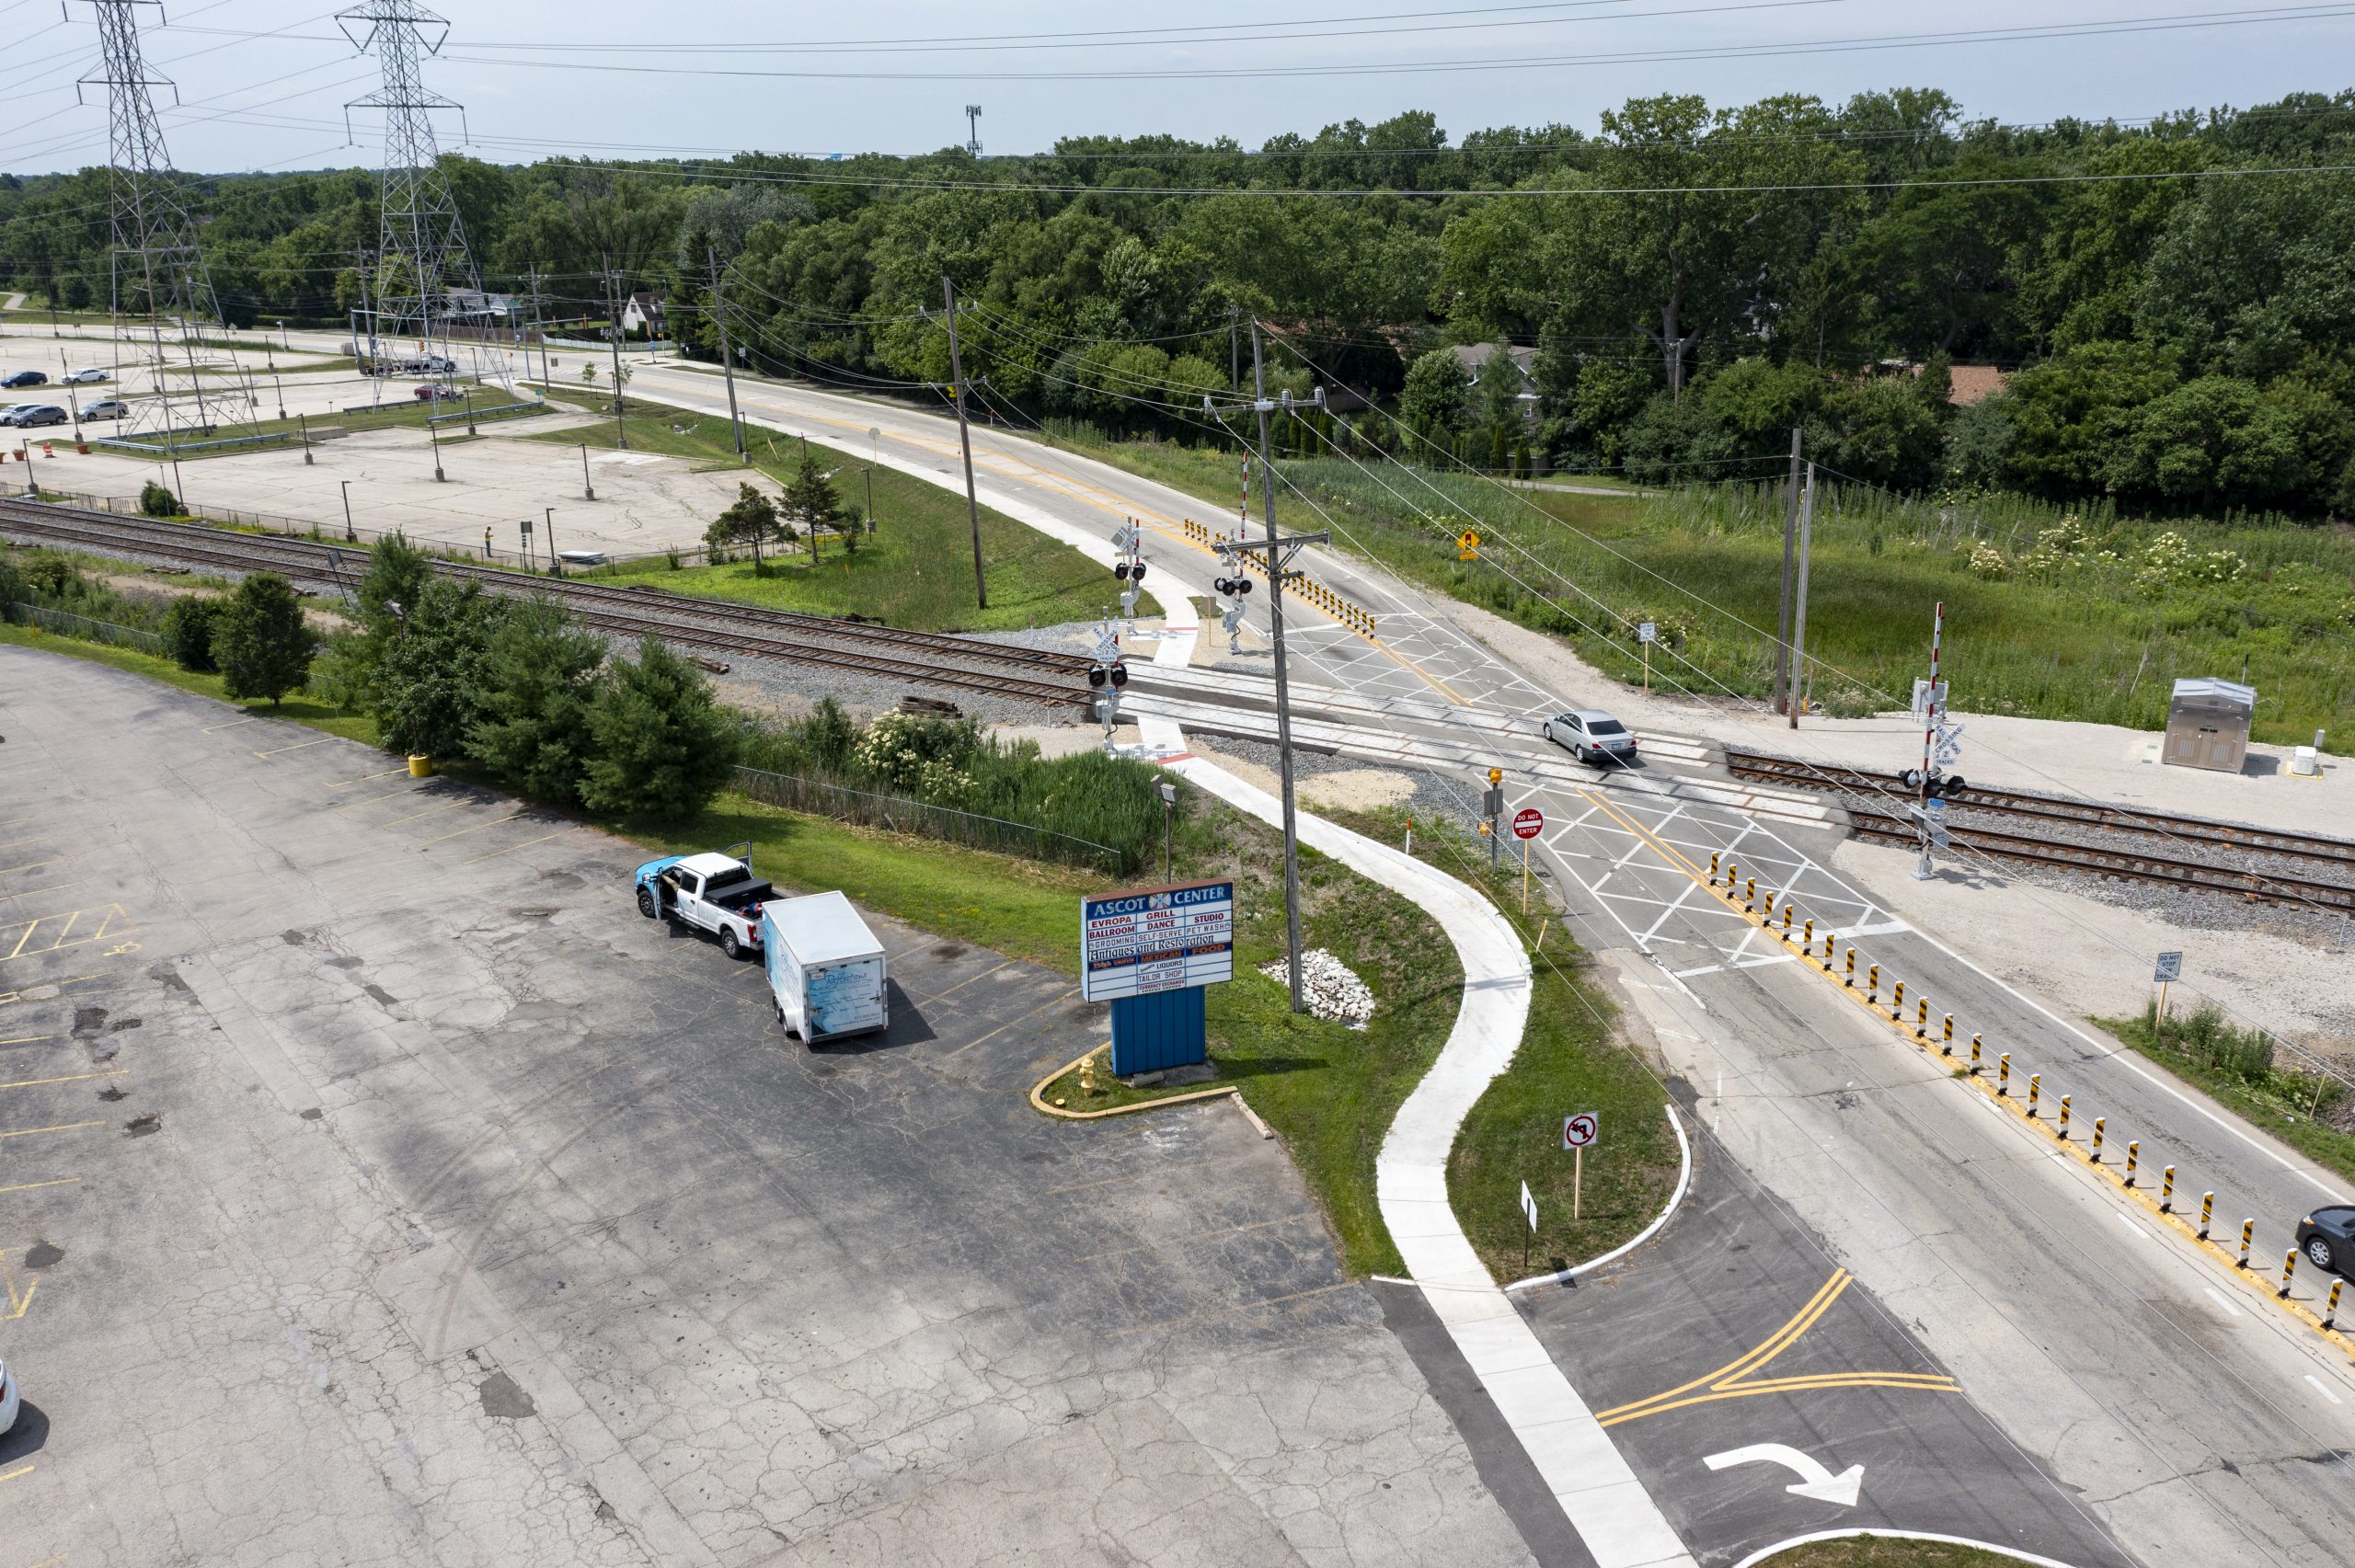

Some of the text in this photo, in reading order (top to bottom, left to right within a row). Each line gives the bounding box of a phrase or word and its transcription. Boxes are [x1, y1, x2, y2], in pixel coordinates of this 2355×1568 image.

[1094, 628, 1103, 638] RAIL
[1097, 630, 1117, 651] CROSSING
[1936, 725, 1961, 754] RAIL ROAD
[1936, 727, 1962, 753] CROSSING
[1094, 887, 1224, 916] ASCOT CENTER
[1089, 912, 1223, 939] BALLROOM DANCE STUDIO
[1091, 910, 1175, 928] EVROPA GRILL
[1095, 936, 1134, 948] GROOMING
[1138, 929, 1182, 942] SELF-SERVE
[1203, 923, 1224, 933] WASH
[1090, 934, 1214, 961] Antiques and Restoration
[1141, 951, 1181, 963] MEXICAN
[1191, 944, 1225, 956] FOOD
[1156, 960, 1183, 969] LIQUORS
[826, 971, 867, 986] Reflections
[1139, 970, 1182, 982] TAILOR SHOP
